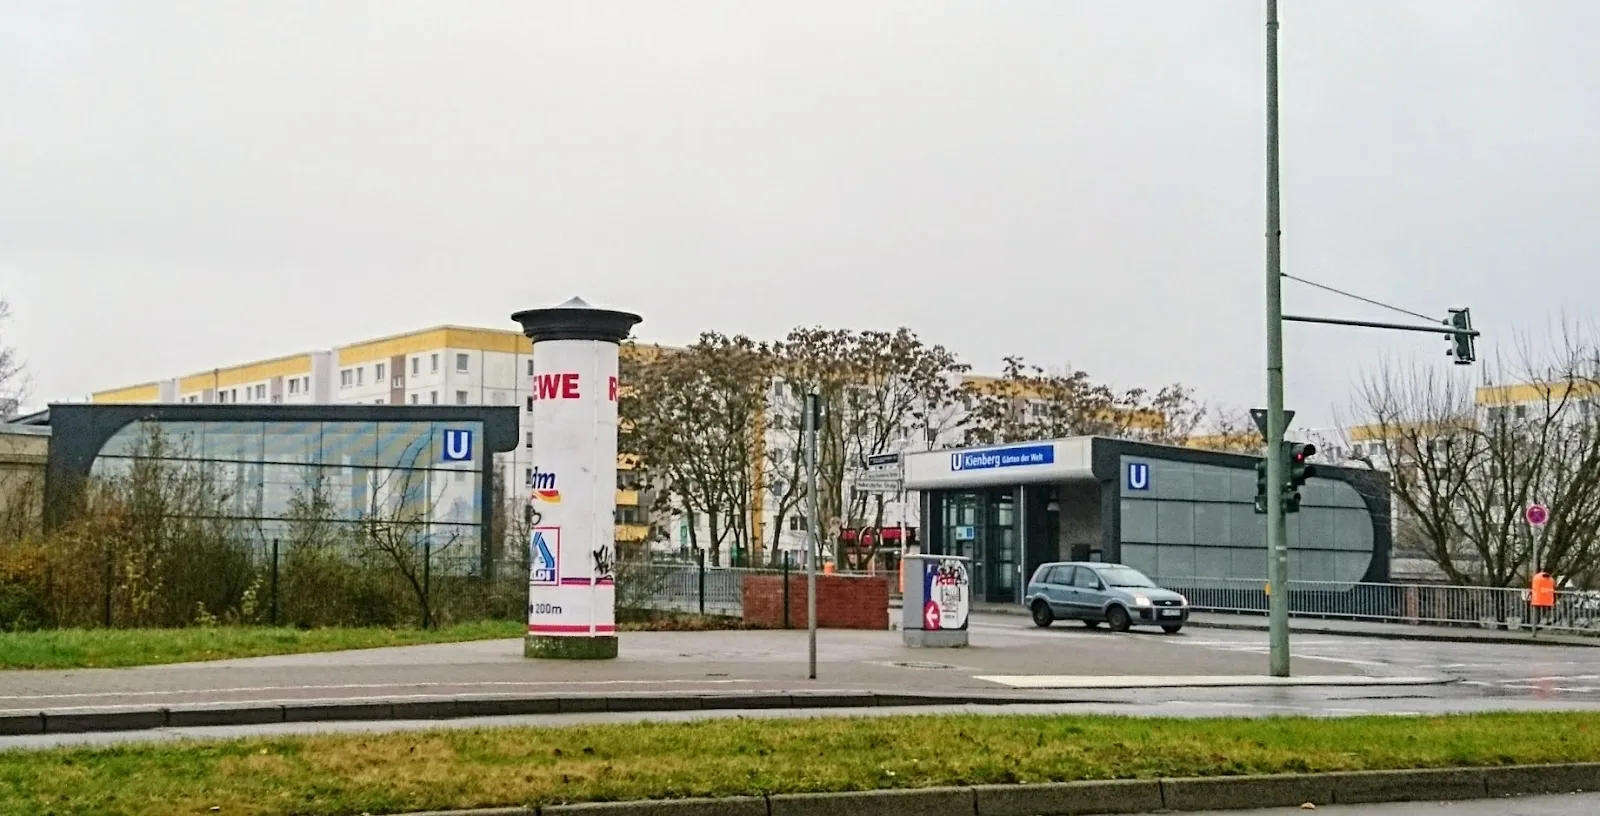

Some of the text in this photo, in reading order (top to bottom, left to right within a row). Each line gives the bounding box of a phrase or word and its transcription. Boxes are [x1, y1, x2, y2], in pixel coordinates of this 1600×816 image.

[447, 430, 469, 459] U
[952, 453, 962, 471] U
[965, 453, 1000, 467] Kienberg
[1020, 454, 1031, 462] der
[1031, 453, 1044, 461] Welt
[1130, 464, 1147, 489] U
[535, 603, 562, 614] 200m
